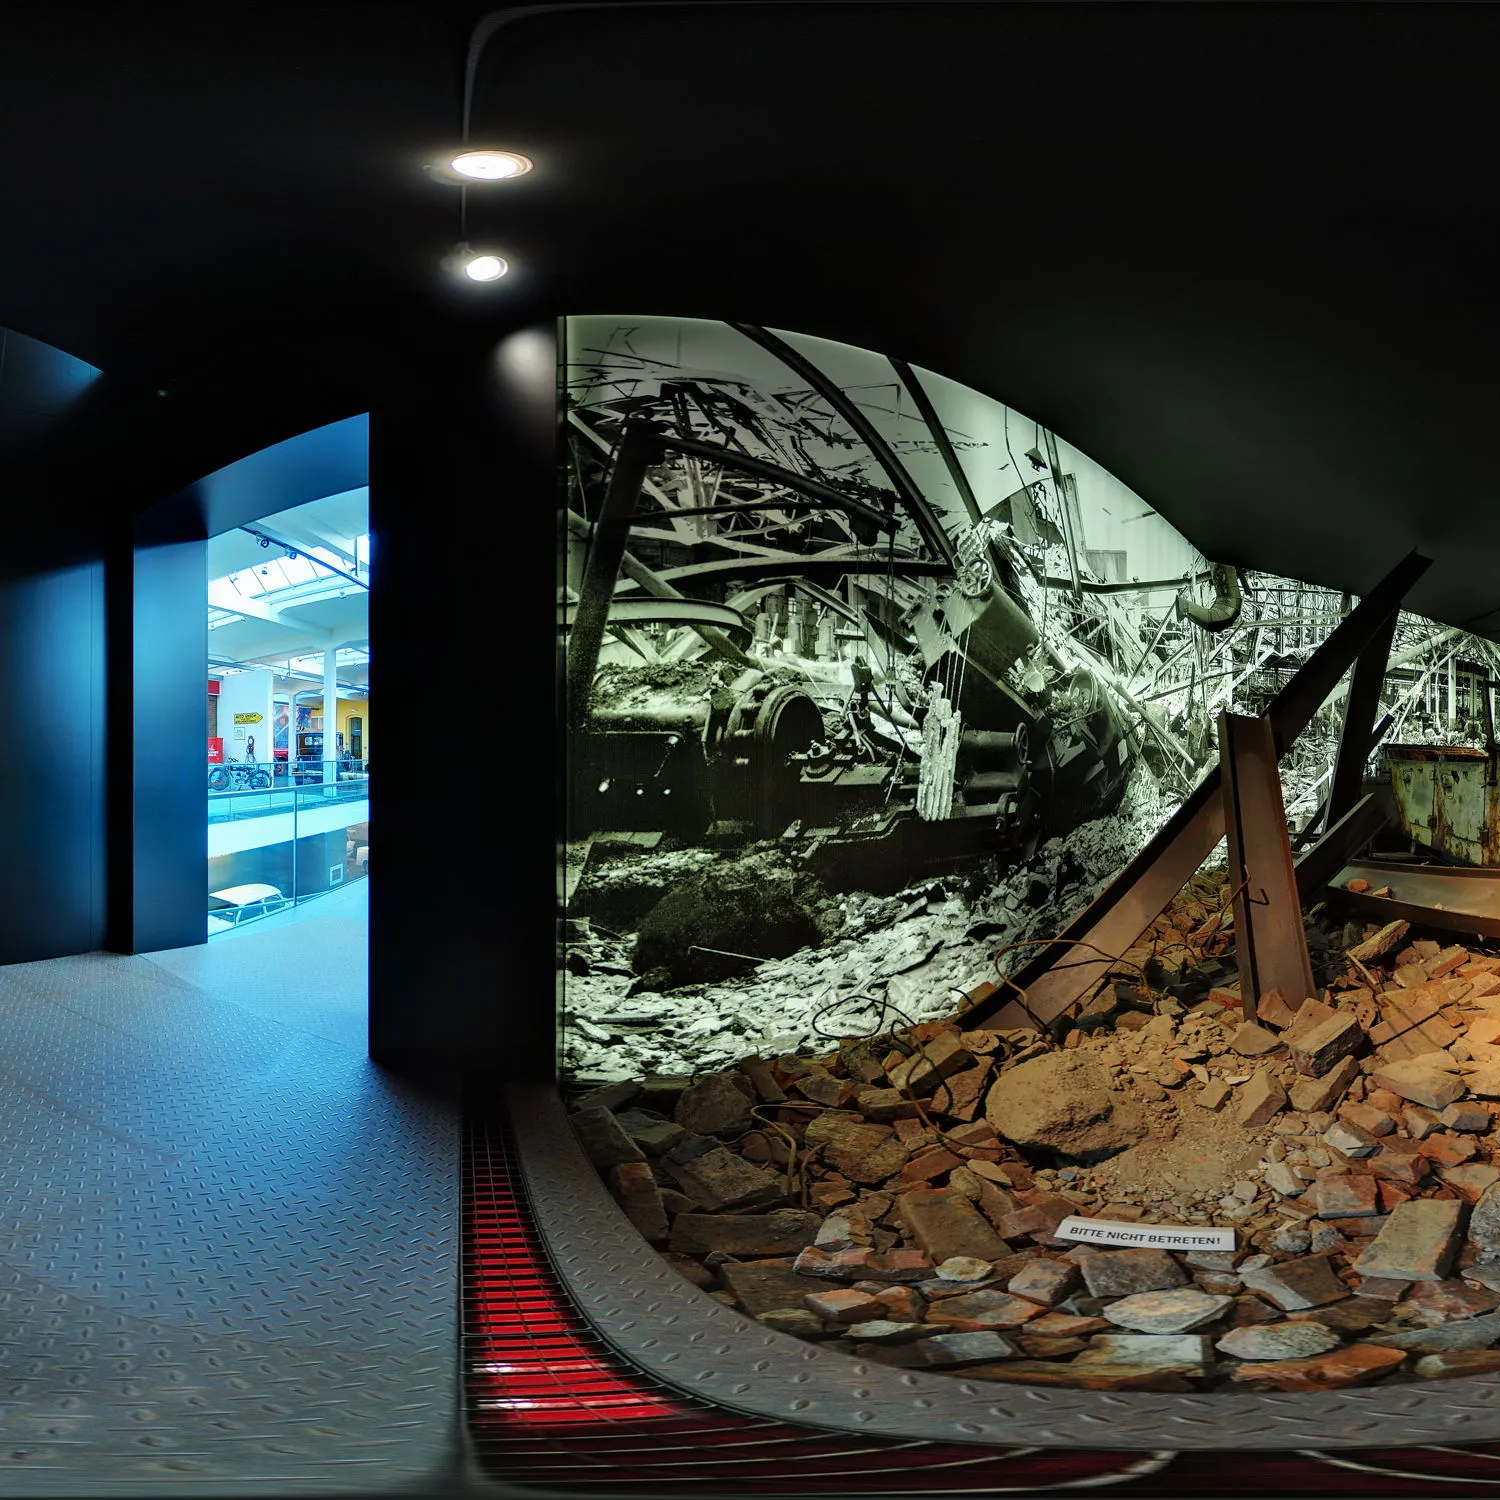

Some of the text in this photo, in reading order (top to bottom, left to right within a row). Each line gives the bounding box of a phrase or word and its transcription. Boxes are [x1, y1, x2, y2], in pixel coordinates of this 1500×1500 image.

[1070, 1226, 1221, 1245] BITTE NICHT BETRETEN!
